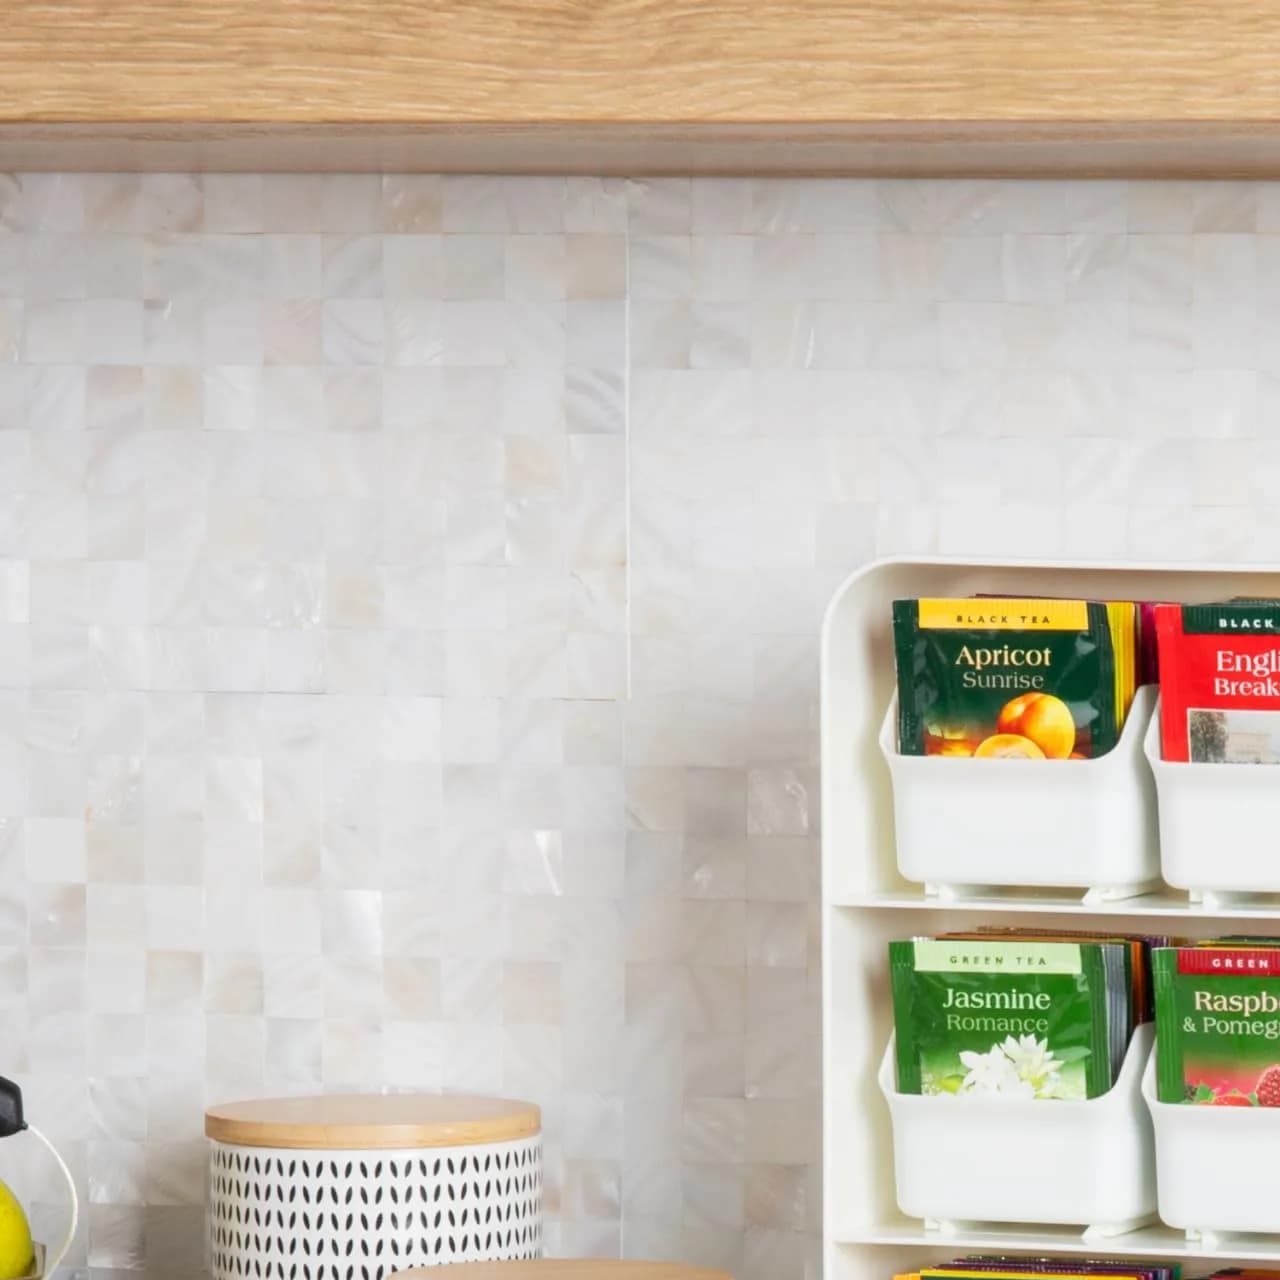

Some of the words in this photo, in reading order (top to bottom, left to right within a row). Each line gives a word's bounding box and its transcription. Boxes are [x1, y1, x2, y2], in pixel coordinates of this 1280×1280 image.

[956, 615, 1008, 623] BLACK
[1020, 615, 1050, 624] TEA
[1219, 619, 1274, 628] BLACK
[955, 645, 1052, 670] Apricot
[962, 671, 1044, 689] Sunrise
[950, 956, 1003, 965] GREEN
[1016, 957, 1046, 966] TEA
[1212, 959, 1269, 969] GREEN
[943, 988, 1051, 1010] Jasmine
[946, 1014, 1049, 1032] Romance
[1183, 1017, 1197, 1033] &
